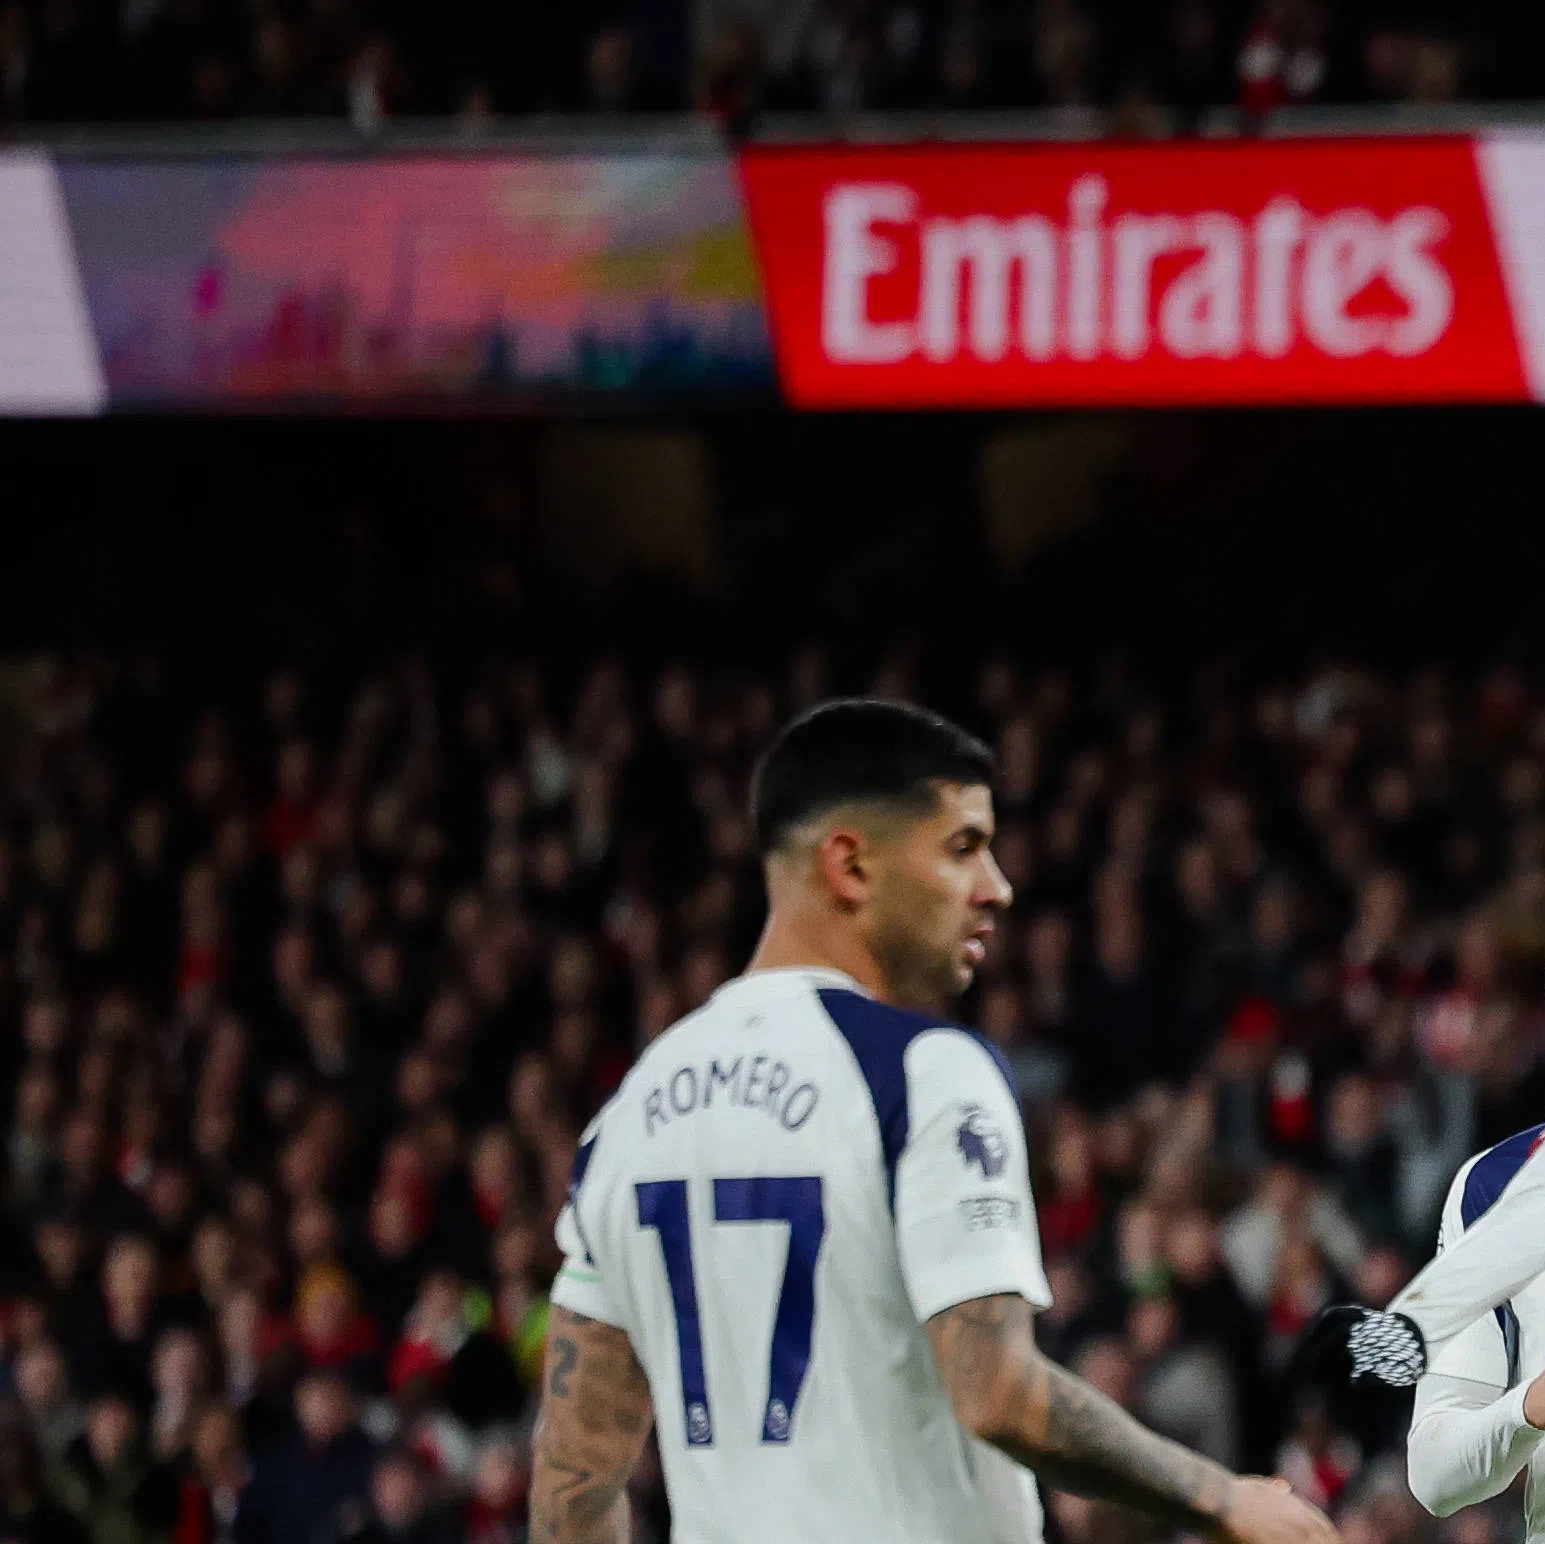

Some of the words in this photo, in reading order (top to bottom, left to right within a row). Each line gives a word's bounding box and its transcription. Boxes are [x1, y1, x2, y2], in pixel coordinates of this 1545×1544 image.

[821, 174, 1452, 362] Emirates
[643, 1055, 820, 1138] ROMERO
[634, 1176, 826, 1446] 17
